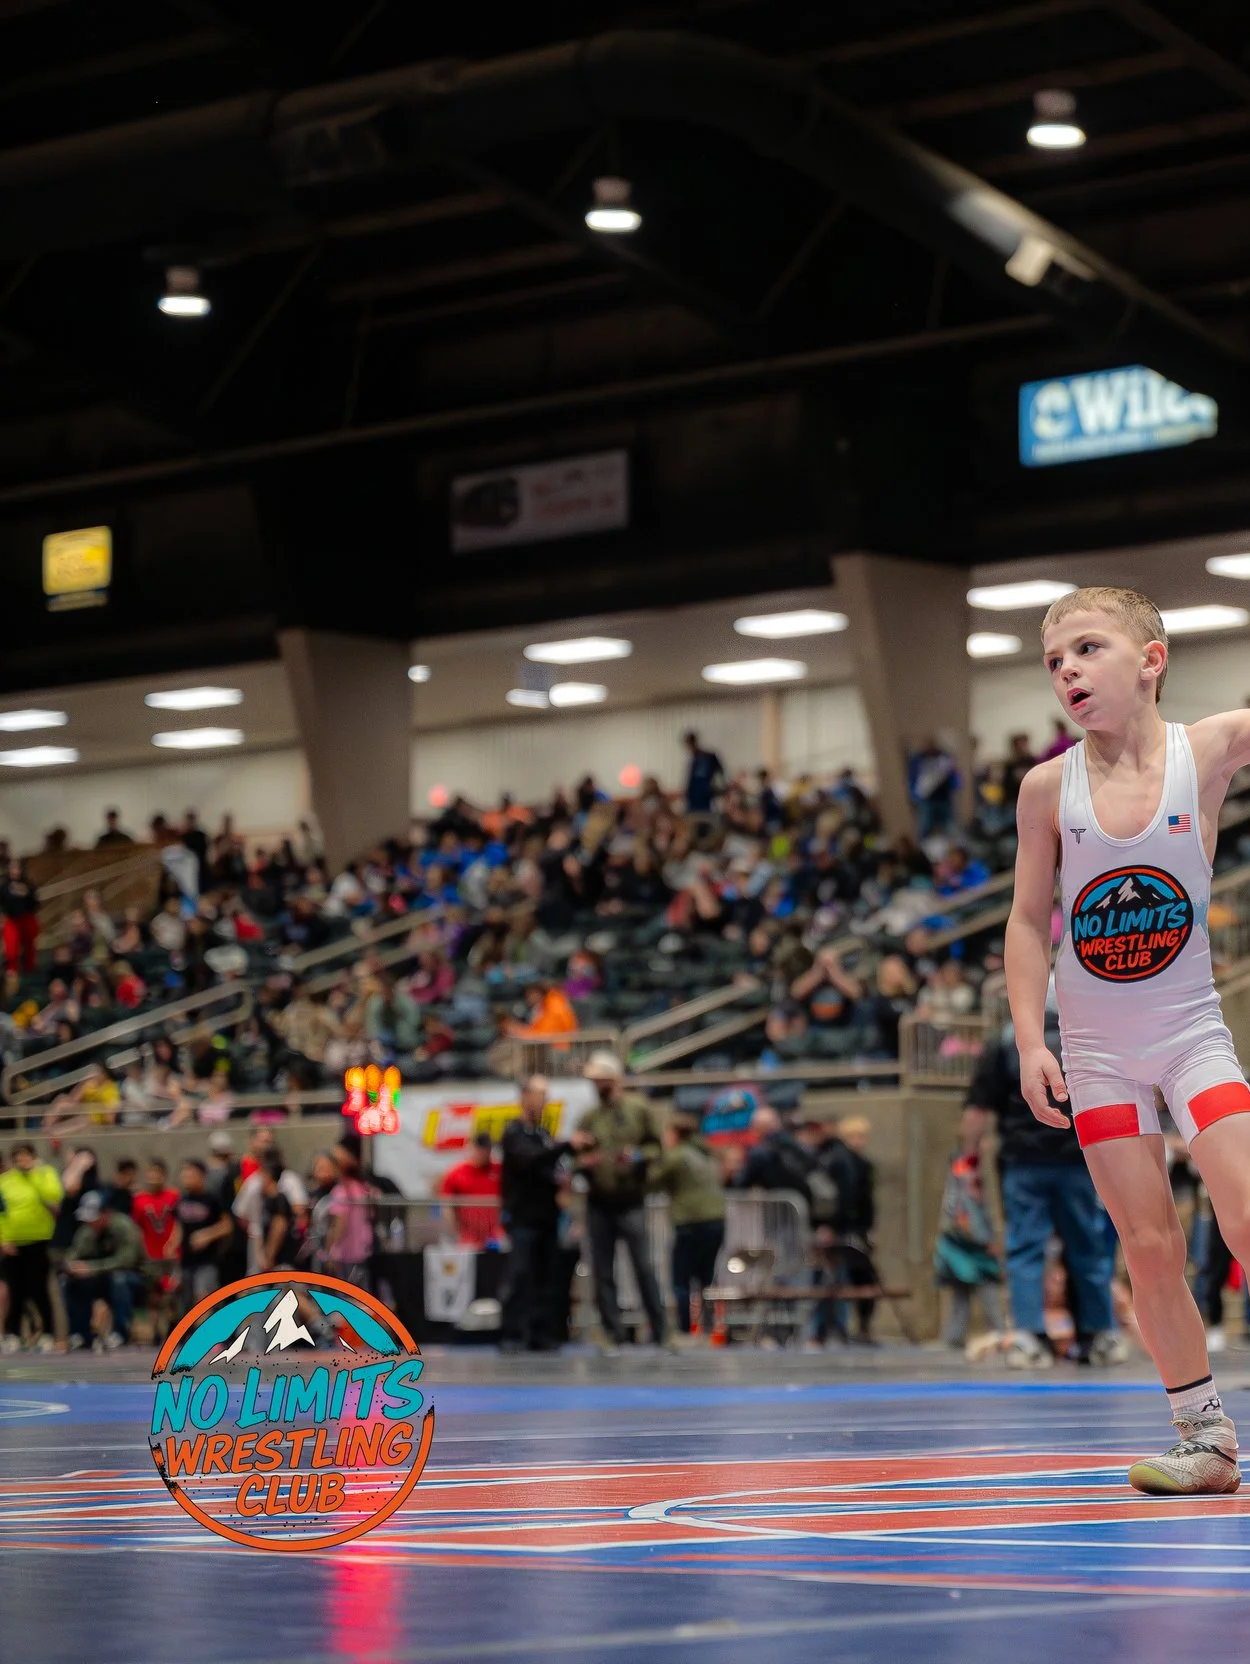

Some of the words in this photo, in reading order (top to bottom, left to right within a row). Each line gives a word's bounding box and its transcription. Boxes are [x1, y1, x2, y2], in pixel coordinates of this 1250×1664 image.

[1074, 913, 1102, 941] NO
[1104, 902, 1187, 935] LIMITS
[1080, 928, 1179, 957] WRESTLING
[1105, 952, 1152, 971] CLUB
